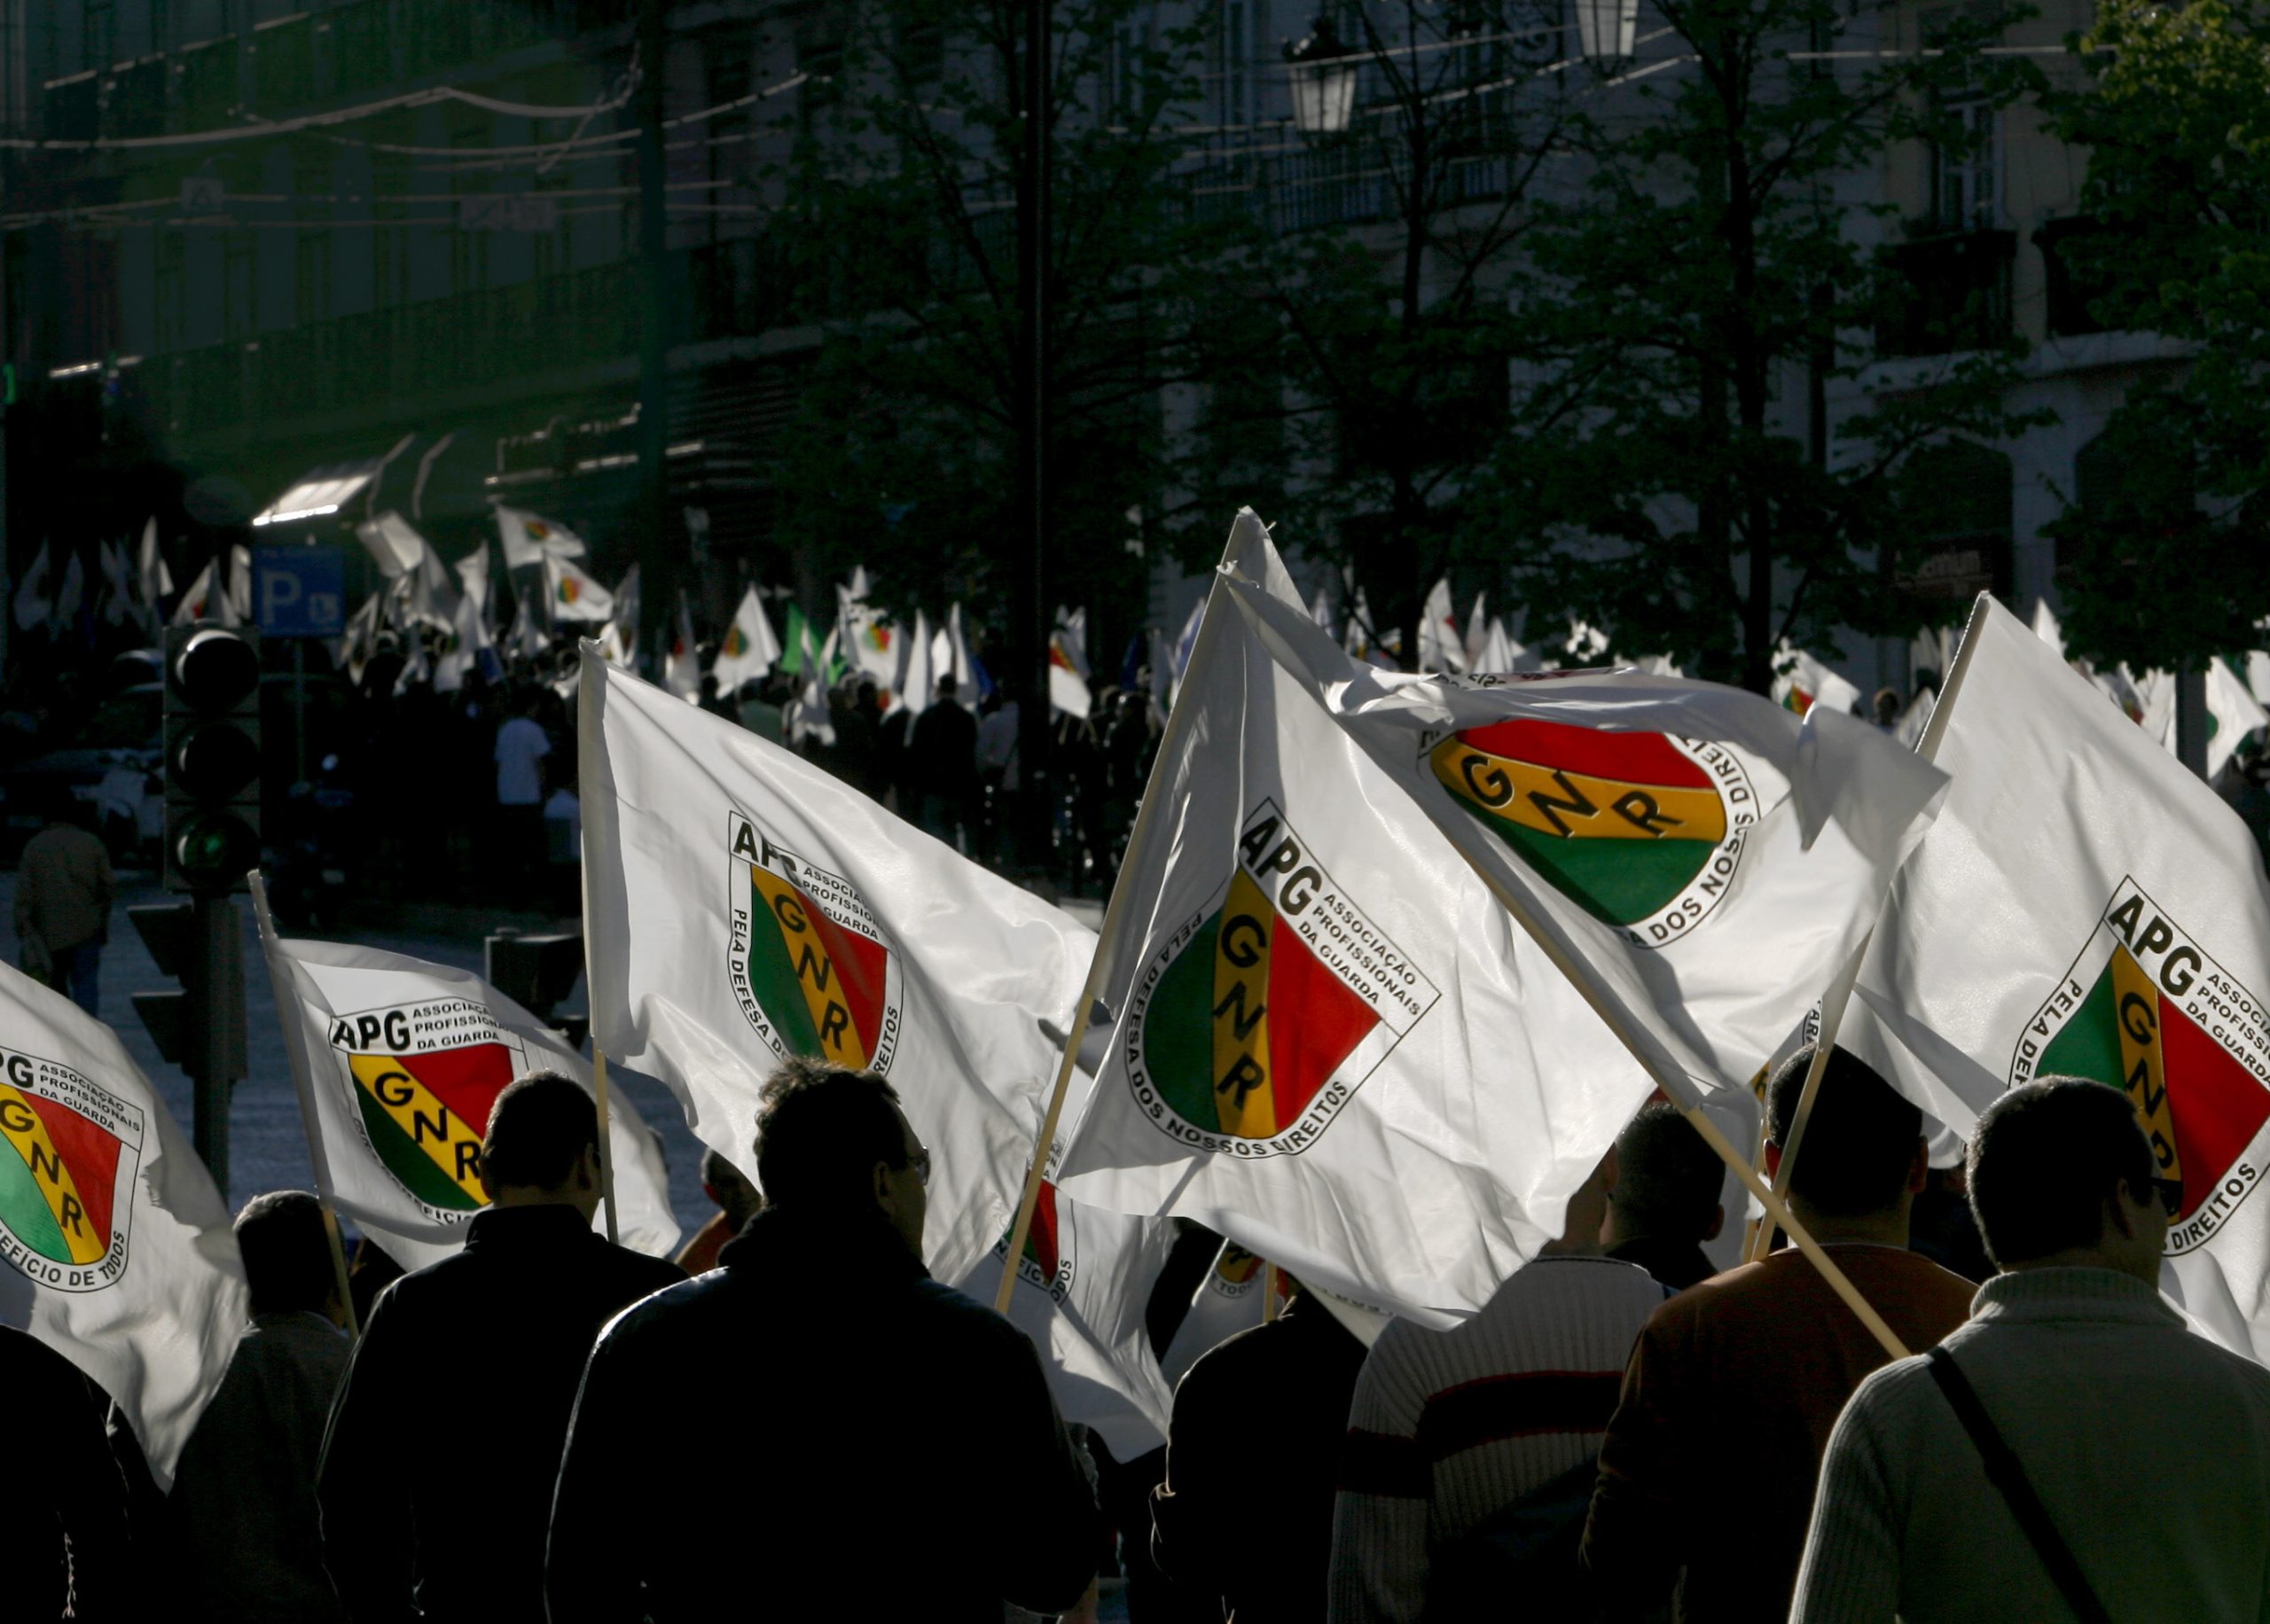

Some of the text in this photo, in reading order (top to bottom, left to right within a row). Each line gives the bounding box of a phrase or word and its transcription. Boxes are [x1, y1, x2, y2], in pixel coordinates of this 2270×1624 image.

[261, 567, 302, 627] P
[1462, 755, 1685, 839] GNR
[802, 879, 879, 926] PROFISSIO
[803, 868, 863, 903] ASSOCIA
[1240, 815, 1322, 916] APG
[1324, 894, 1416, 985] ASSOCIAÇÃO
[1648, 897, 1702, 941] DOS
[2108, 894, 2202, 996] APG
[732, 909, 770, 1038] PELA DEFESA
[774, 894, 849, 1051] GNR
[1298, 921, 1381, 1004] DA GUARDA
[1312, 906, 1421, 1016] PROFISSIONAIS
[332, 1010, 411, 1052] APG
[417, 1040, 436, 1050] DA
[873, 1005, 897, 1072] REITOS
[1128, 913, 1348, 1155] PELA DEFESA DOS NOSSOS DIREITOS
[1211, 914, 1266, 1111] GNR
[2186, 1001, 2208, 1026] DA
[2197, 986, 2270, 1061] PROFISSI
[40, 1064, 124, 1113] ASSOCIAÇÃO
[40, 1074, 140, 1132] PROFISSIONAIS
[40, 1088, 115, 1131] DA GUARDA
[2015, 979, 2257, 1251] PELA DEF DIREITOS
[374, 1072, 481, 1181] GNR
[0, 1098, 82, 1238] GNR
[0, 1229, 124, 1286] EFÍCIO DE TODOS
[1050, 1260, 1072, 1301] ODOS
